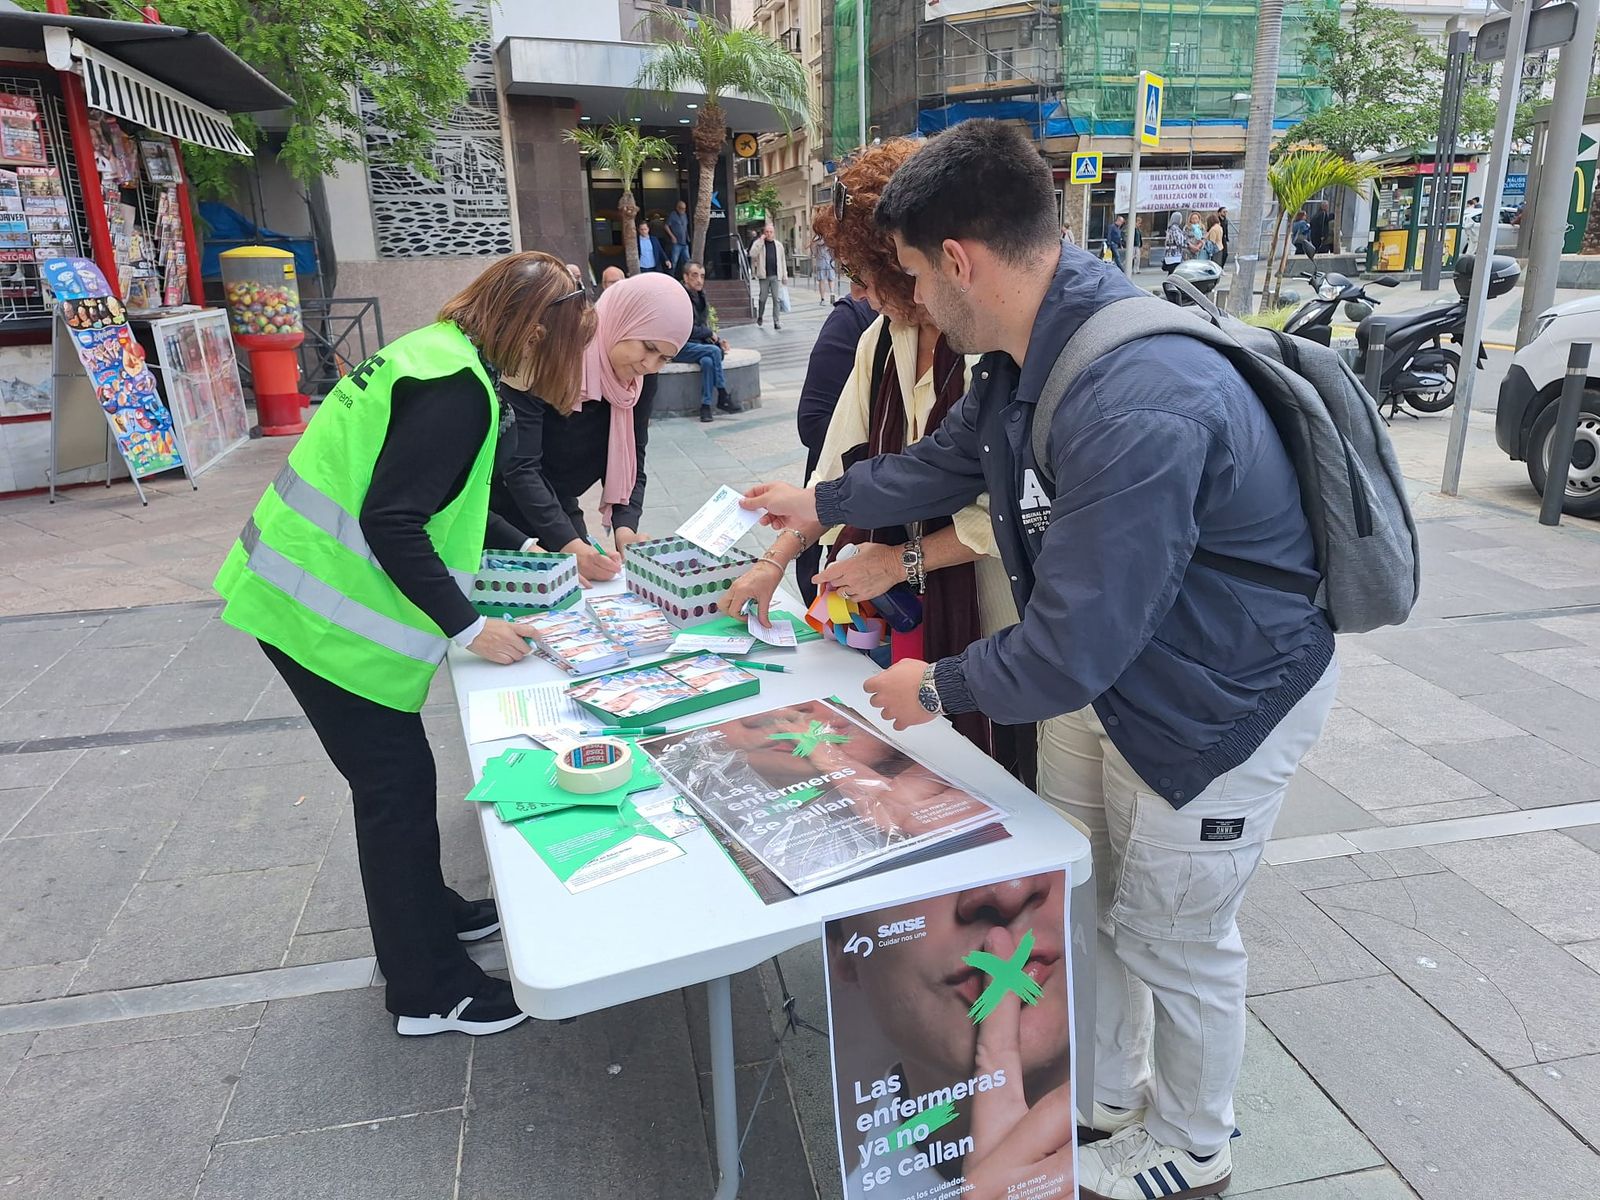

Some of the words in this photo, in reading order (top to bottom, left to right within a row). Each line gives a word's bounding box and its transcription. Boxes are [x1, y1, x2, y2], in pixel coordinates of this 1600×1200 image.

[712, 783, 757, 801] Las
[726, 766, 857, 812] enfermeras
[738, 807, 771, 827] ya
[774, 799, 804, 813] no
[752, 821, 782, 836] se
[785, 797, 856, 825] callan
[877, 915, 926, 938] SATSE
[878, 937, 901, 948] Cuidar
[901, 935, 914, 943] nos
[913, 931, 927, 940] une
[853, 1073, 902, 1105] Las
[856, 1068, 1008, 1133] enfermeras
[857, 1134, 891, 1169] ya
[896, 1122, 930, 1149] no
[862, 1165, 892, 1193] se
[897, 1134, 976, 1177] callan
[915, 1188, 929, 1200] los
[929, 1175, 967, 1199] cuidados.
[1007, 1184, 1017, 1194] 12
[1016, 1181, 1027, 1191] de
[1026, 1174, 1047, 1187] mayo
[1020, 1173, 1064, 1198] Internacional
